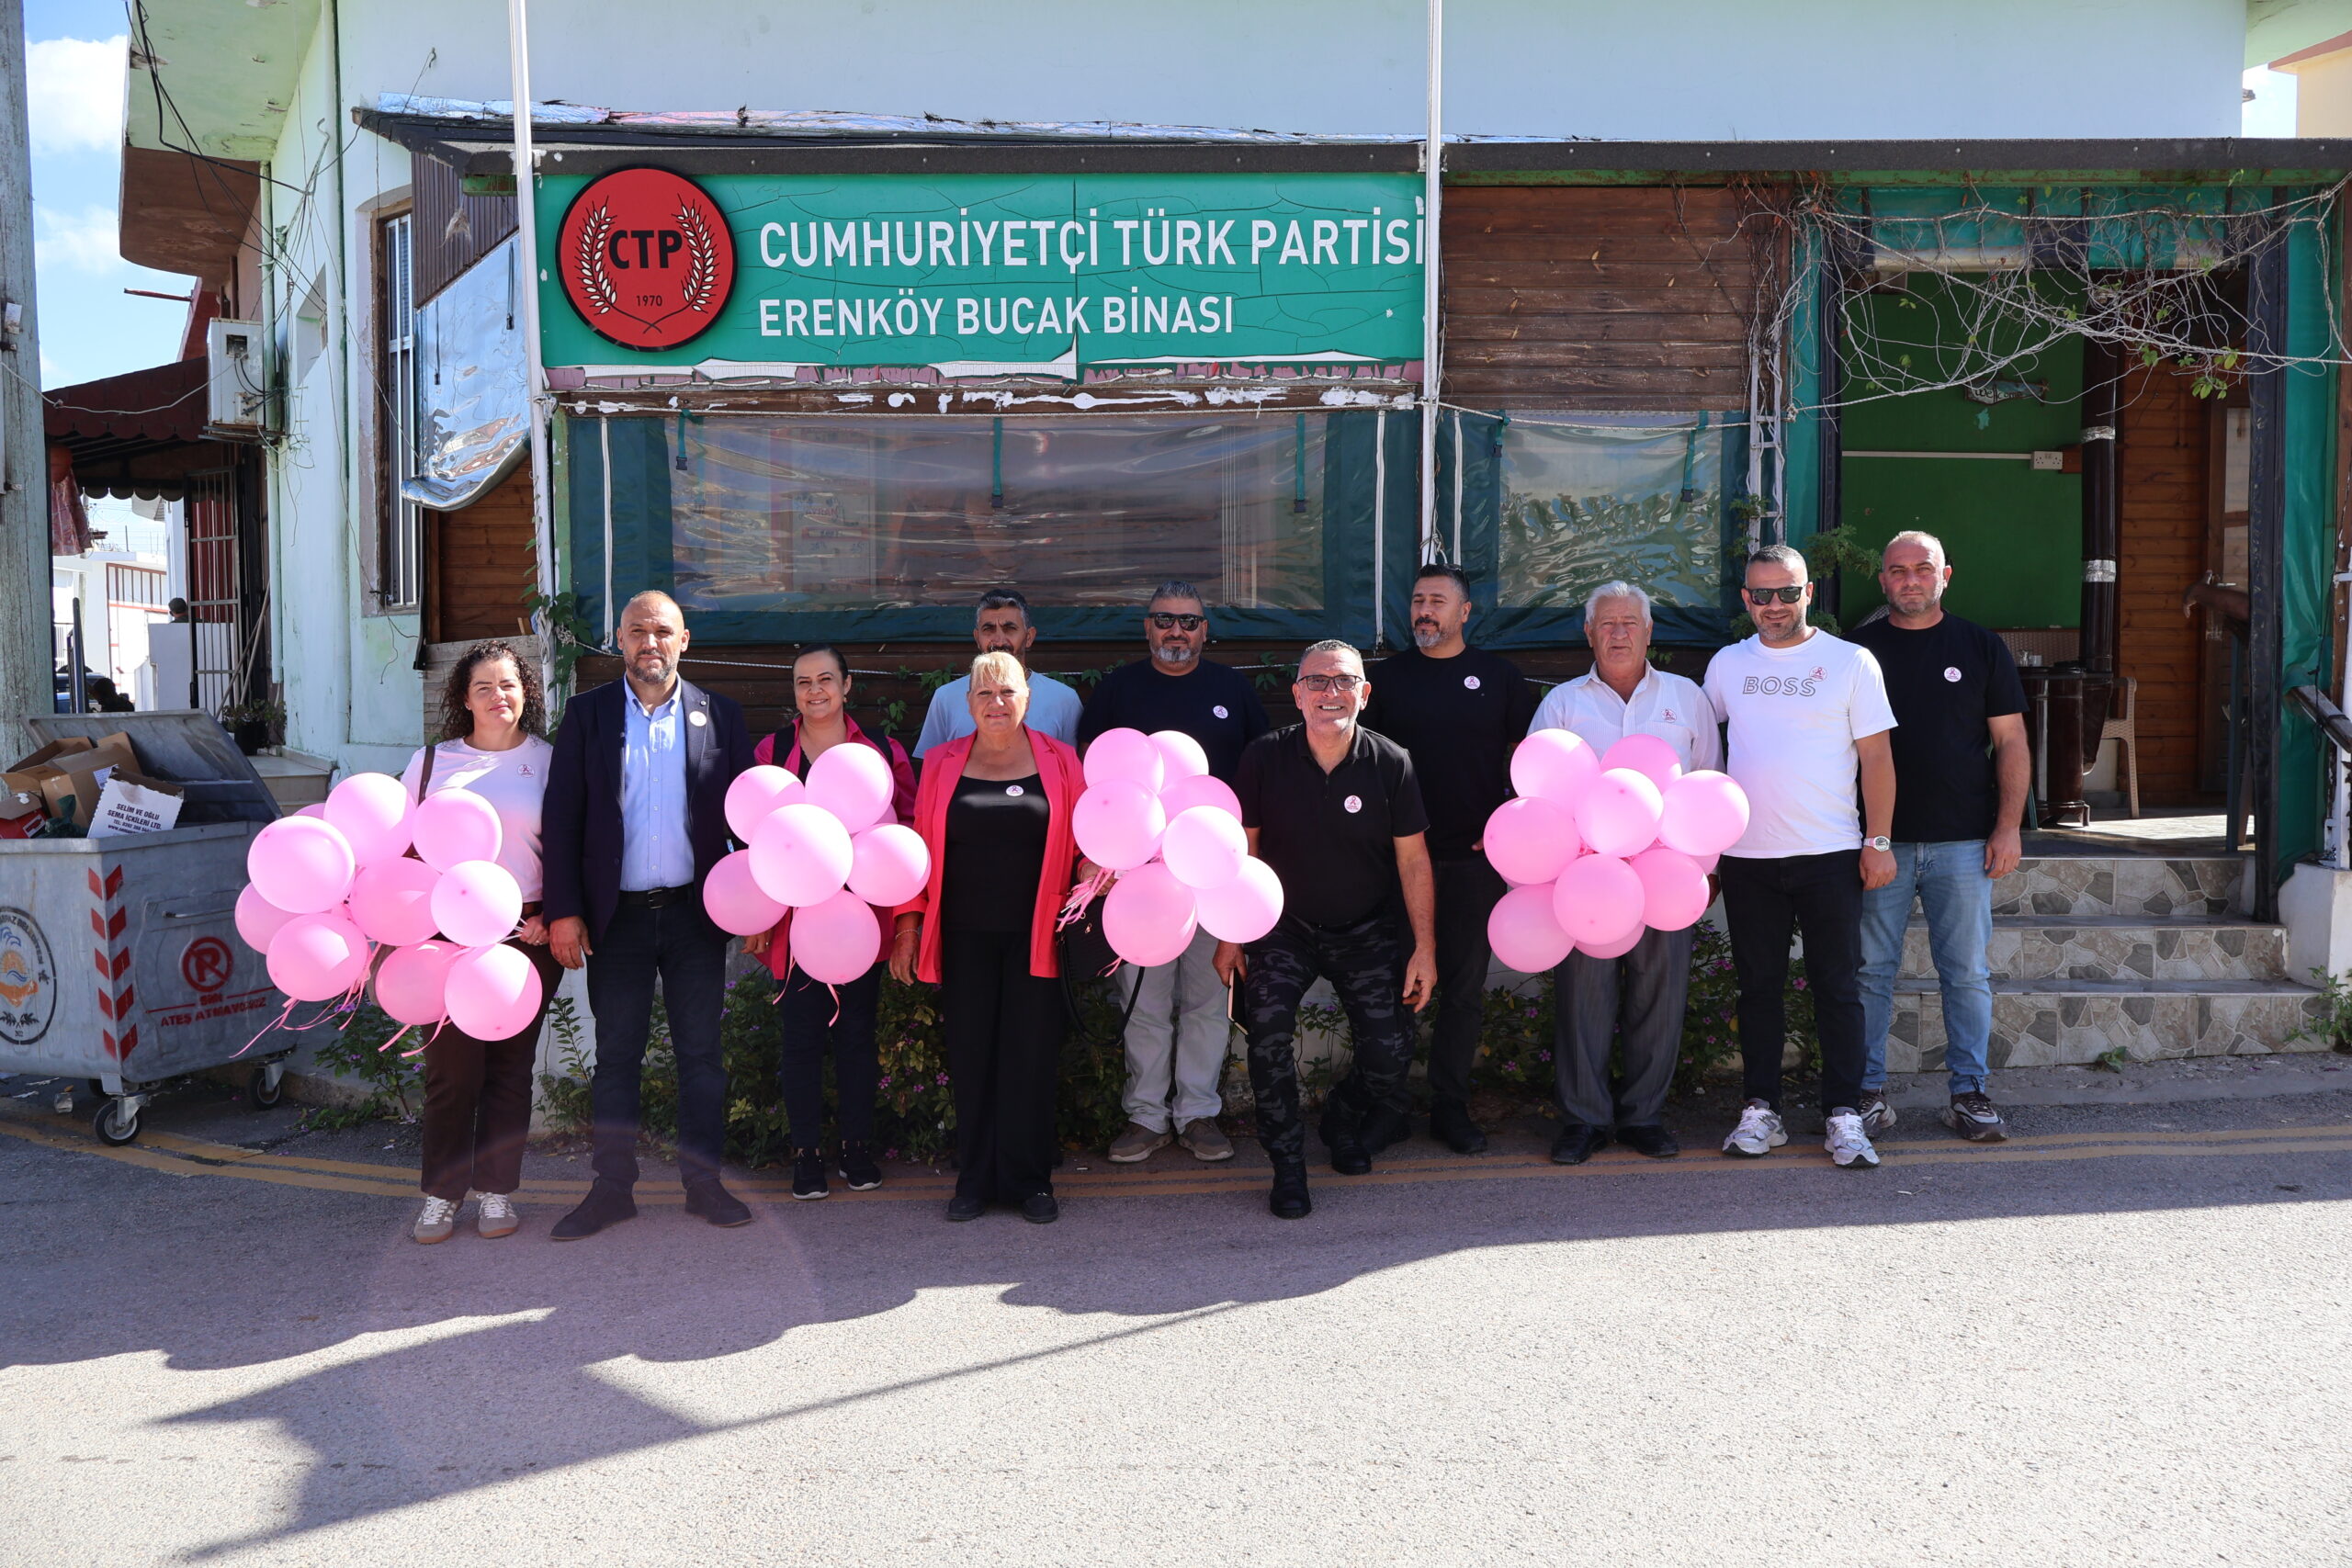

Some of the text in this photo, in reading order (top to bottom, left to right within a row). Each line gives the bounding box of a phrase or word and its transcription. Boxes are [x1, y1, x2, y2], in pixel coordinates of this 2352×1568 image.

[608, 229, 683, 270] CTP
[760, 206, 1425, 275] CUMHURİYETÇİ TÜRK PARTİSİ
[636, 294, 663, 307] 1970
[759, 286, 1232, 337] ERENKÖY BUCAK BİNASI
[1742, 676, 1816, 697] BOSS
[107, 809, 125, 819] SEMA
[135, 807, 143, 817] VE
